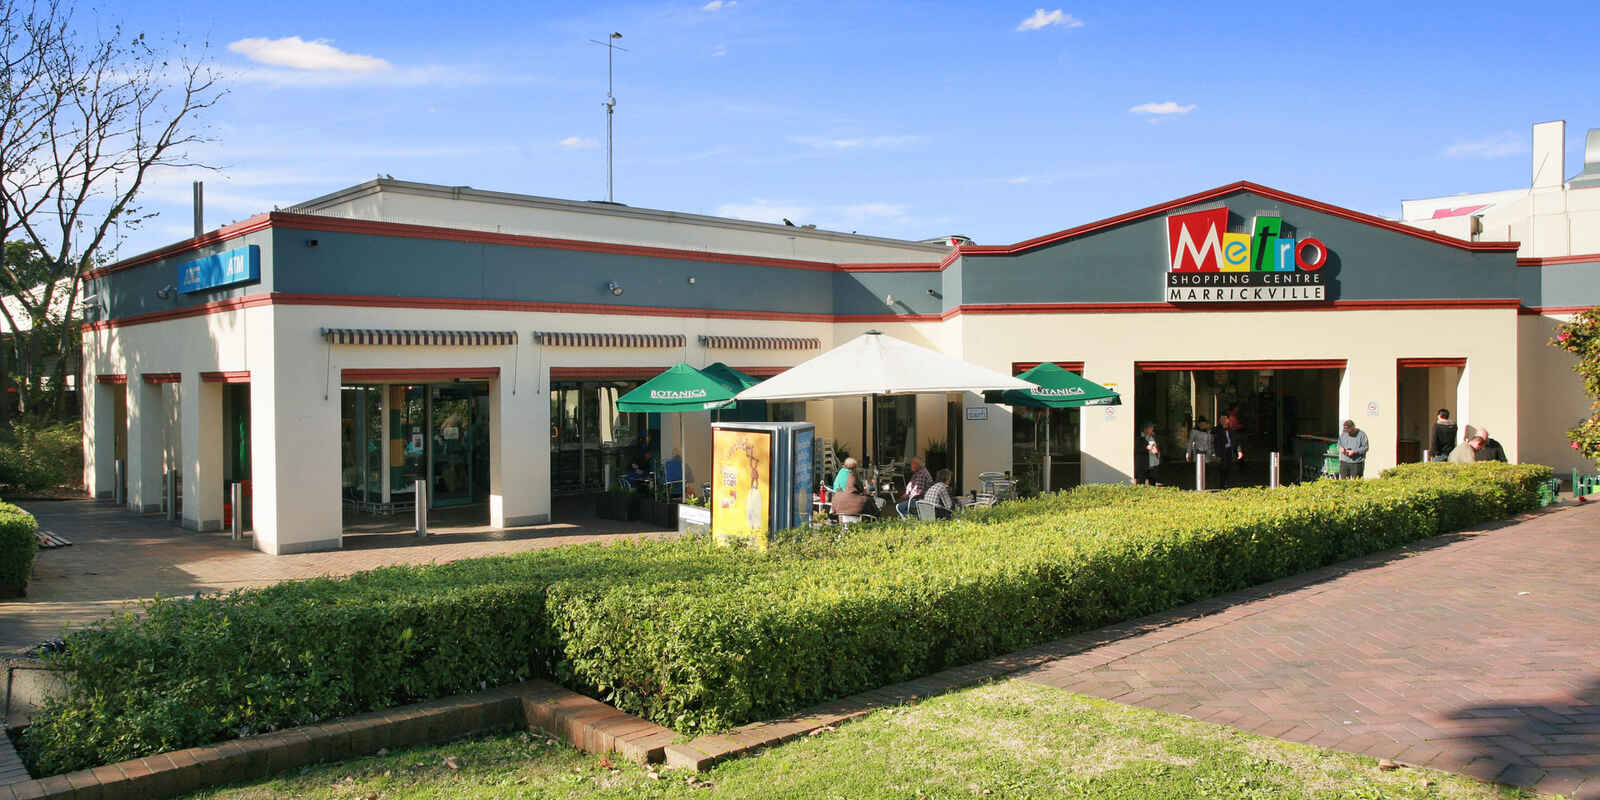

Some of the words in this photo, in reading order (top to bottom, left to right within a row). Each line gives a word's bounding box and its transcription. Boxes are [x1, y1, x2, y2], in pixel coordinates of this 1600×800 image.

[1172, 221, 1328, 272] Metro
[226, 255, 244, 277] ATM
[1171, 274, 1250, 284] SHOPPING
[1263, 273, 1320, 283] CENTRE
[1170, 288, 1321, 300] MARRICKVILLE
[650, 389, 706, 399] BOTANICA
